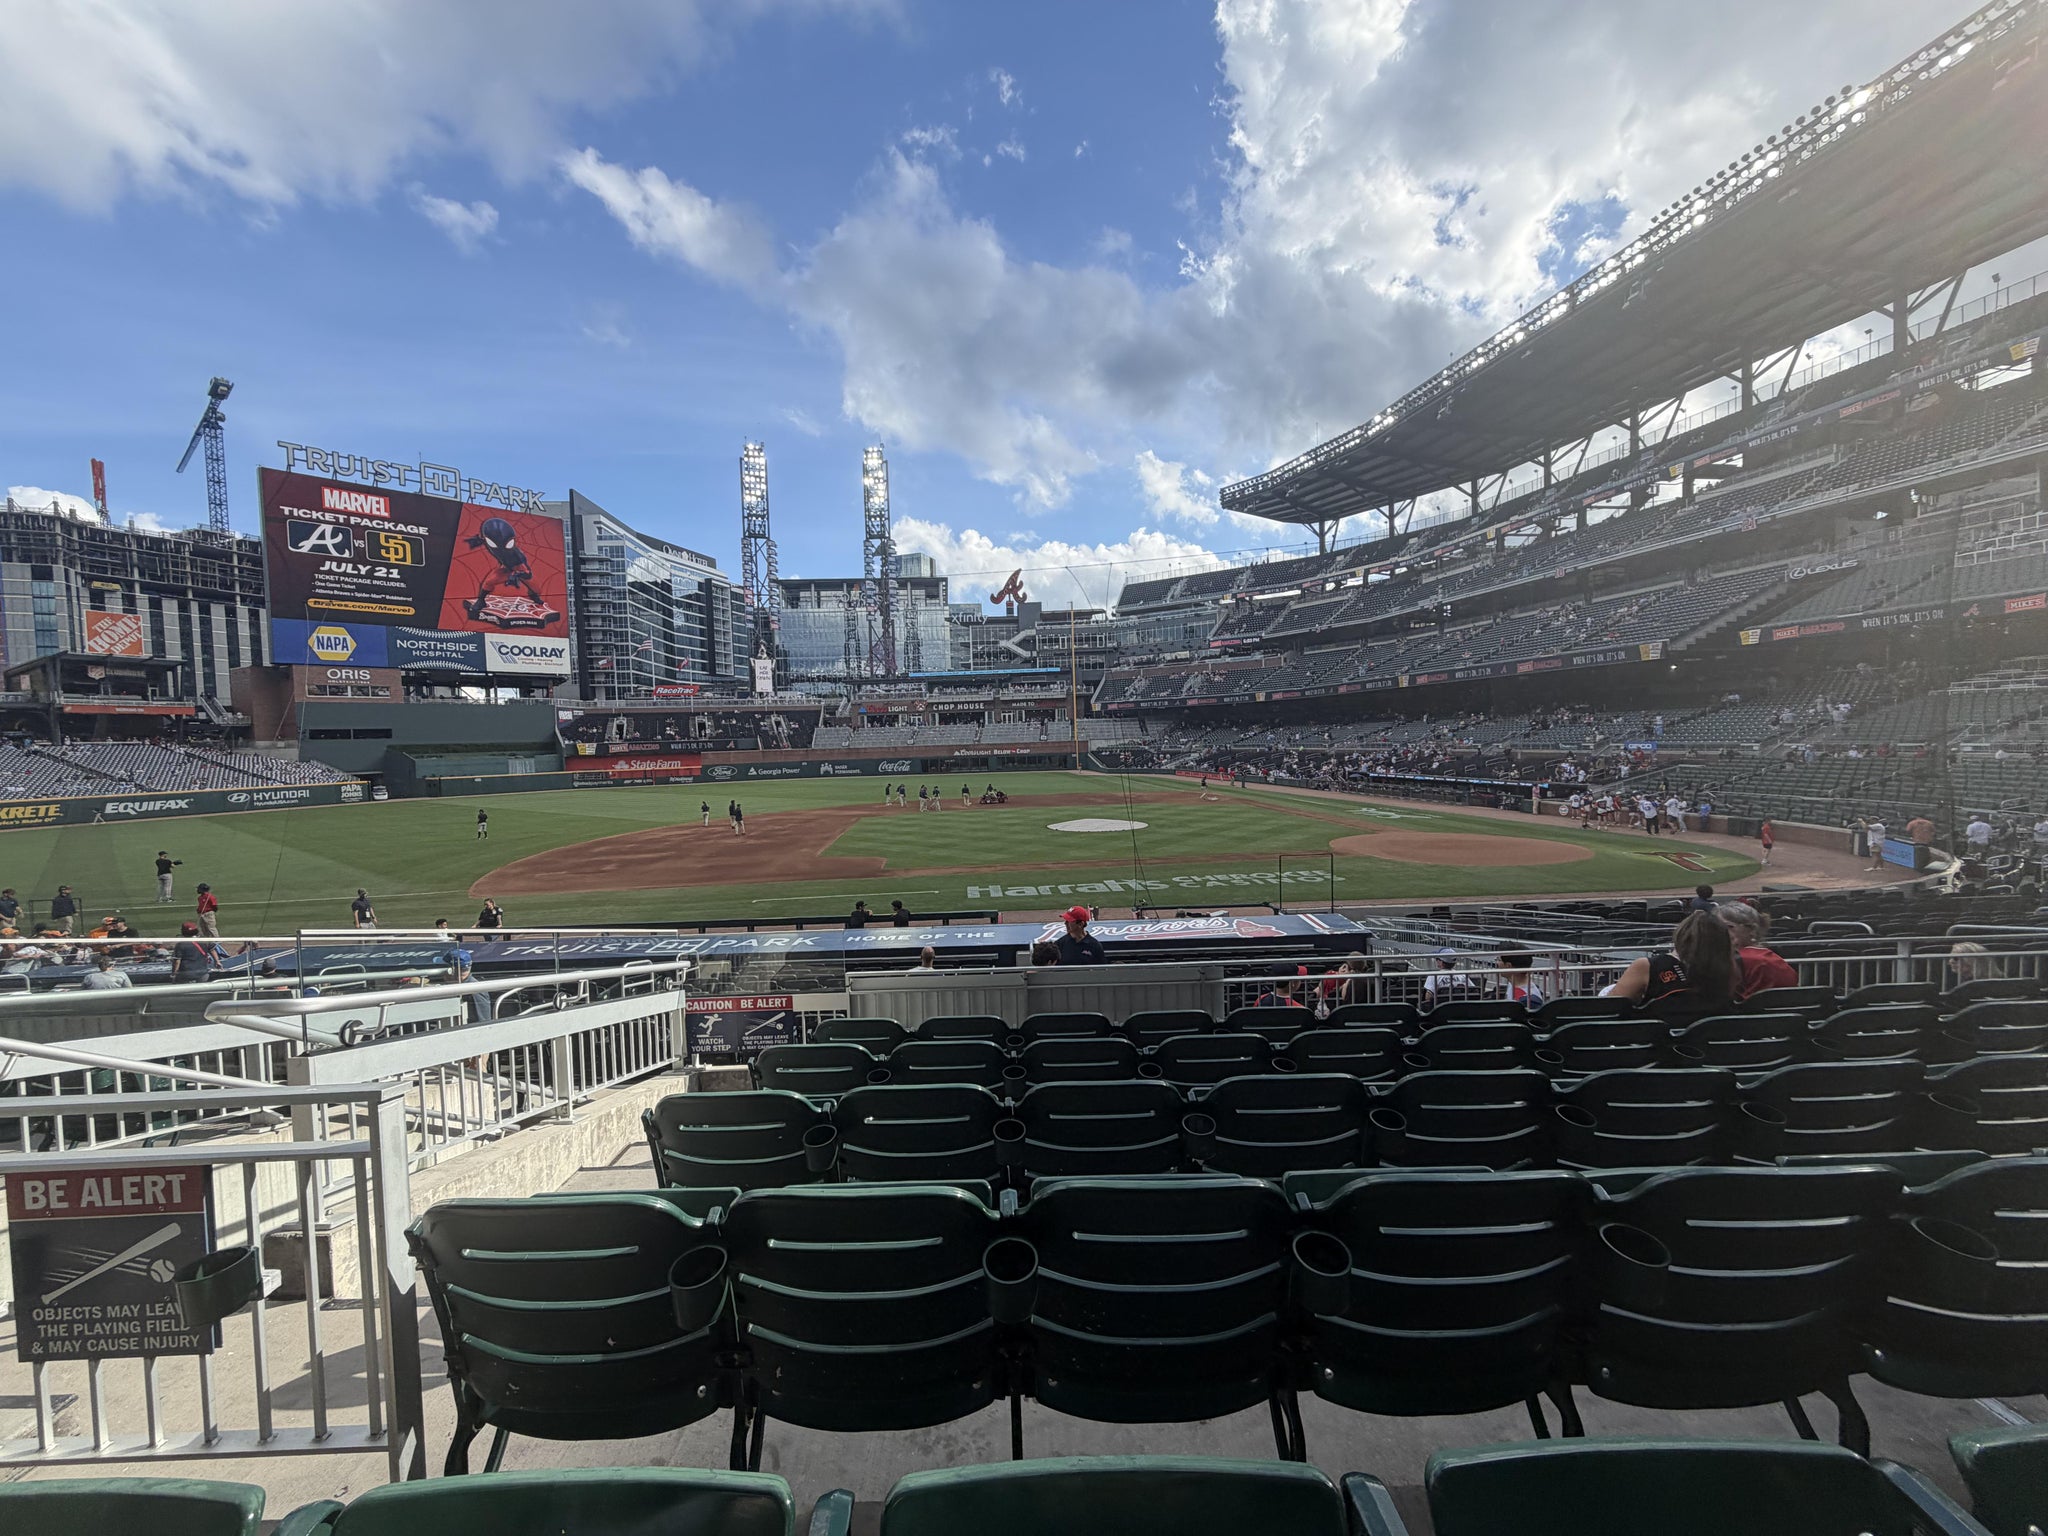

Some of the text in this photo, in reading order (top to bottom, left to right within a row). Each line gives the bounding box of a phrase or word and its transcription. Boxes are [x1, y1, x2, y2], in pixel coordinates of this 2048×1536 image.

[277, 440, 546, 512] TRUIST PARK
[324, 488, 388, 516] MARVEL
[280, 506, 429, 536] TICKET PACKAGE
[354, 540, 364, 548] VS
[380, 532, 412, 565] SD
[320, 560, 400, 578] JULY 21
[1808, 560, 1858, 574] LEXUS
[340, 576, 372, 584] PACKAGE
[373, 578, 406, 588] INCLUDES:
[313, 600, 411, 613] Braves.com/Marvel
[2010, 598, 2042, 610] MIKE'S
[92, 616, 116, 633] THE
[952, 613, 988, 625] xfinity
[1862, 617, 1881, 628] WHEN
[1882, 614, 1898, 626] IT'S
[1914, 611, 1931, 622] IT'S
[88, 615, 142, 654] HOME
[1776, 629, 1796, 638] MIKE'S
[110, 630, 142, 654] DEPOT
[316, 635, 350, 652] NAPA
[396, 640, 478, 652] NORTHSIDE
[412, 650, 464, 658] HOSPITAL
[498, 644, 565, 658] COOLRAY
[327, 668, 370, 680] ORIS
[714, 767, 732, 776] Ford
[254, 790, 310, 800] HYUNDAI
[104, 799, 189, 815] EQUIFAX
[1171, 870, 1332, 884] CHEROKEE
[1179, 875, 1346, 889] CASINOS
[846, 934, 909, 942] HOME
[500, 936, 824, 956] TRUIST PARK
[324, 950, 439, 960] WELCOME
[686, 1000, 732, 1011] CAUTION
[740, 998, 787, 1008] BE ALERT
[23, 1174, 186, 1210] BE ALERT
[32, 1302, 182, 1321] OBJECTS MAY LEA
[38, 1324, 68, 1337] THE
[73, 1321, 142, 1336] PLAYING
[32, 1334, 200, 1354] & MAY CAUSE INJURY
